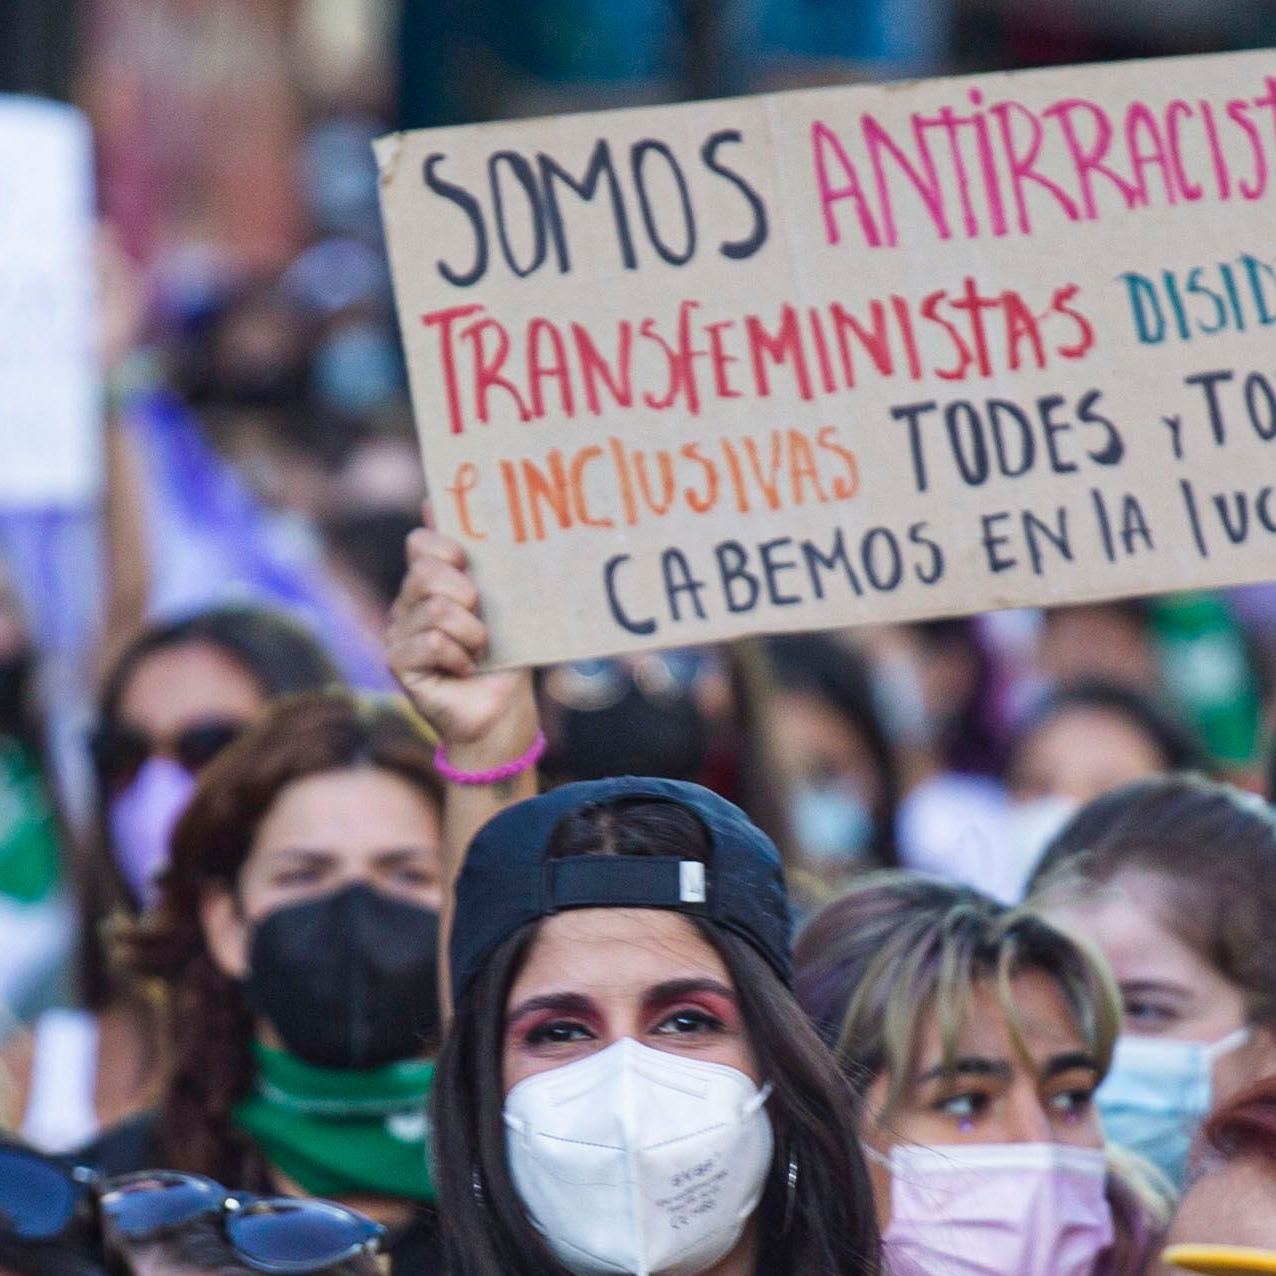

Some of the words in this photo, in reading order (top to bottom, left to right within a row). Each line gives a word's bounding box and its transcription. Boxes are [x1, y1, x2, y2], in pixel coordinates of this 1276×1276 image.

[423, 130, 770, 288] SOMOS
[891, 389, 1124, 492] TODES
[604, 521, 945, 636] CABEMOS
[980, 506, 1074, 577] EN
